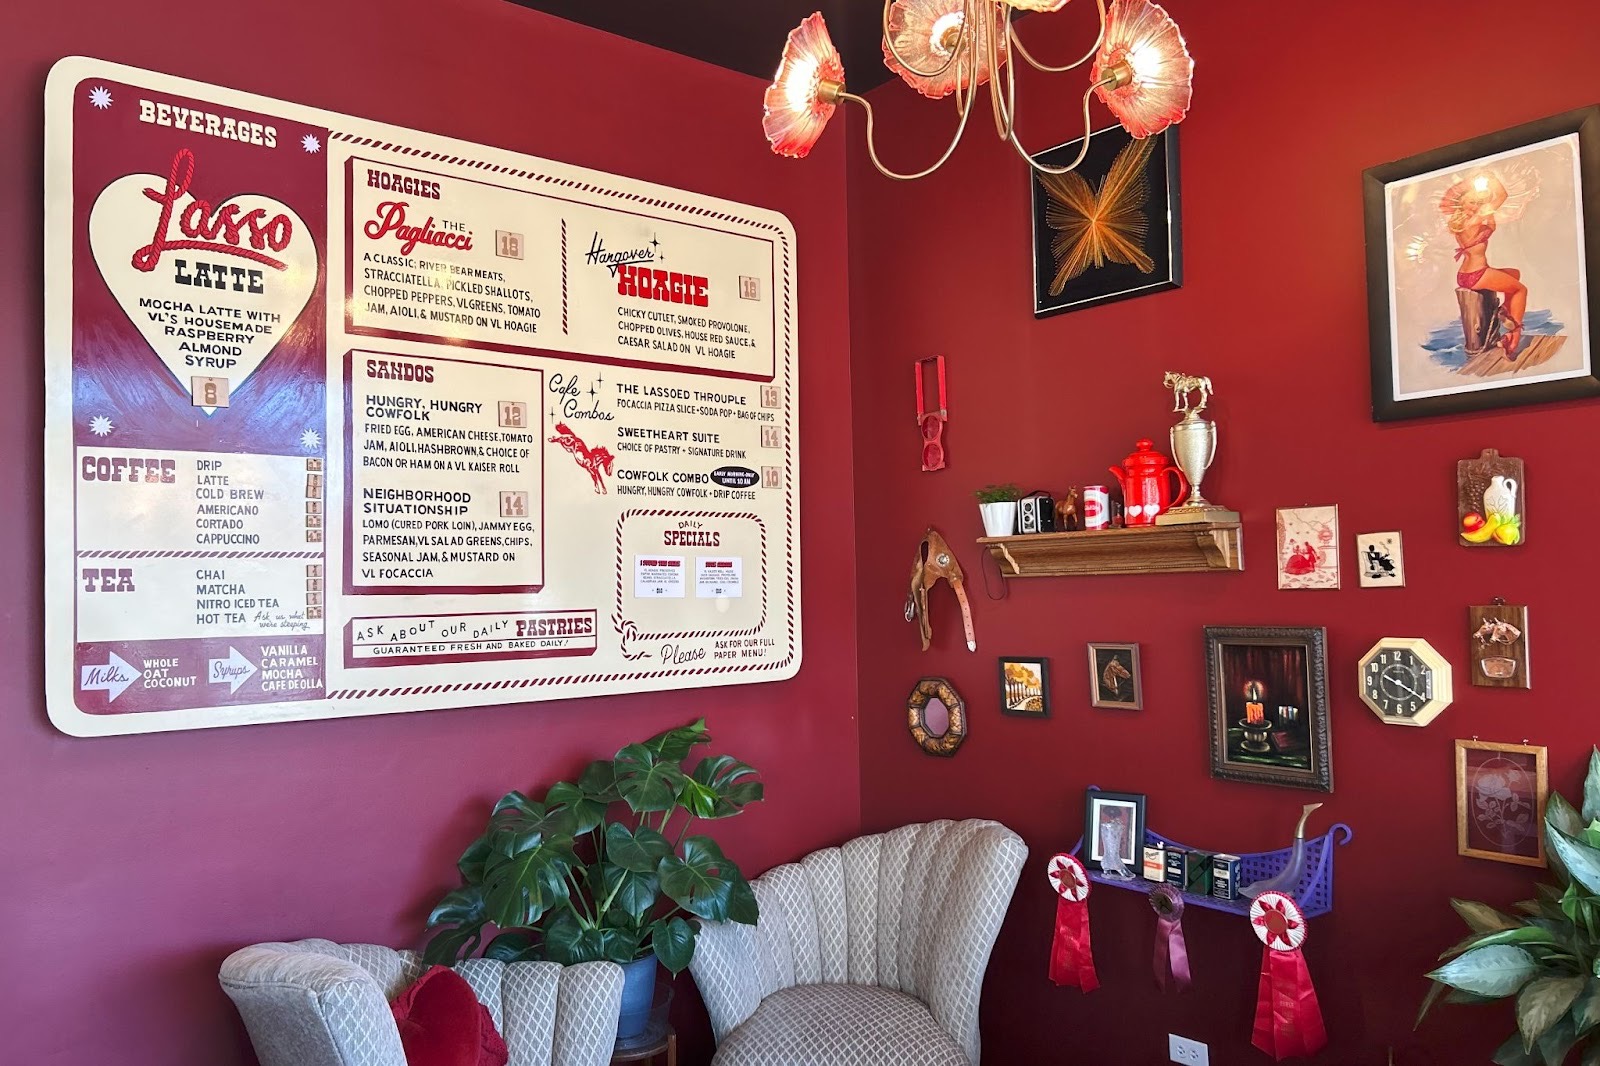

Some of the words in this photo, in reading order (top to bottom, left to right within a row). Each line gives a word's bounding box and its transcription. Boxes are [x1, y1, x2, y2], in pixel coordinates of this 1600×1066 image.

[139, 99, 277, 148] BEVERAGES
[368, 169, 440, 200] HOAGIES
[131, 148, 293, 272] Lasso
[364, 201, 473, 256] Pagliacci
[442, 220, 465, 232] THE
[502, 236, 518, 256] 18
[585, 231, 654, 278] Hangover
[420, 261, 446, 272] RIVER
[175, 259, 263, 294] LATTE
[447, 279, 483, 294] PICKLED
[485, 284, 533, 303] SHALLOTS,
[617, 264, 708, 307] HOAGIE
[364, 285, 408, 301] CHOPPED
[508, 304, 540, 318] TOMATO
[140, 298, 193, 312] MOCHA
[200, 305, 241, 318] LATTE
[247, 310, 281, 323] WITH
[618, 306, 646, 319] CHICKY
[678, 315, 706, 329] SMOKED
[185, 317, 272, 334] HOUSEMADE
[430, 311, 474, 326] MUSTARD
[476, 316, 488, 328] ON
[491, 318, 501, 329] VL
[504, 321, 537, 333] HOAGIE
[165, 326, 254, 343] RASPBERRY
[618, 321, 654, 334] CHOPPED
[685, 330, 708, 342] HOUSE
[709, 334, 723, 344] RED
[179, 342, 242, 356] ALMOND
[618, 335, 649, 349] CAESAR
[653, 340, 678, 352] SALAD
[680, 344, 690, 354] ON
[695, 346, 705, 356] VL
[708, 347, 736, 359] HOAGIE
[185, 355, 236, 368] SYRUP
[367, 360, 434, 383] SANDOS
[549, 373, 580, 404] Cafe
[617, 384, 639, 395] THE
[643, 386, 690, 400] LASSOED
[693, 392, 746, 405] THROUPLE
[366, 395, 425, 409] HUNGRY,
[430, 400, 482, 414] HUNGRY
[563, 398, 614, 422] Combos
[617, 399, 652, 411] FOCACCIA
[654, 402, 675, 412] PIZZA
[700, 406, 719, 417] SODA
[719, 409, 732, 418] POP
[737, 411, 749, 420] BAG
[757, 413, 774, 422] CHIPS
[366, 407, 430, 421] COWFOLK
[504, 407, 521, 425] 12
[365, 424, 391, 434] FRIED
[417, 427, 466, 440] AMERICAN
[502, 432, 532, 443] TOMATO
[617, 427, 689, 441] SWEETHEART
[692, 432, 720, 444] SUITE
[486, 447, 517, 458] CHOICE
[520, 449, 530, 458] OF
[617, 442, 642, 452] CHOICE
[644, 444, 653, 453] OF
[654, 445, 681, 454] PASTRY
[688, 446, 724, 457] SIGNATURE
[725, 449, 746, 459] DRINK
[82, 456, 176, 483] COFFEE
[196, 460, 222, 471] DRIP
[363, 456, 392, 467] BACON
[395, 458, 407, 468] OR
[410, 459, 431, 470] HAM
[434, 460, 445, 470] ON
[446, 461, 452, 470] A
[455, 461, 466, 471] VL
[469, 462, 496, 472] KAISER
[500, 464, 520, 473] ROLL
[197, 475, 229, 486] LATTE
[617, 470, 669, 482] COWFOLK
[672, 472, 709, 484] COMBO
[766, 471, 778, 486] 10
[196, 488, 224, 499] COLD
[230, 489, 264, 500] BREW
[363, 488, 471, 503] NEIGHBORHOOD
[648, 486, 674, 497] HUNGRY
[677, 488, 708, 498] COWFOLK
[713, 490, 730, 499] DRIP
[731, 491, 756, 500] COFFEE
[196, 504, 258, 516] AMERICANO
[363, 503, 468, 515] SITUATIONSHIP
[505, 496, 523, 516] 14
[196, 519, 243, 529] CORTADO
[363, 520, 389, 528] LOMO
[391, 519, 422, 530] (CURED
[426, 521, 449, 530] PORK
[479, 522, 511, 531] JAMMY
[513, 522, 535, 533] EGG,
[678, 521, 703, 529] DAILY
[196, 534, 260, 545] CAPPUCCINO
[431, 536, 463, 546] SALAD
[504, 537, 532, 547] CHIPS,
[664, 531, 720, 547] SPECIALS
[362, 552, 413, 562] SEASONAL
[450, 552, 499, 562] MUSTARD
[502, 553, 515, 561] ON
[196, 569, 225, 580] CHAI
[362, 569, 375, 578] VL
[380, 568, 433, 578] FOCACCIA
[82, 569, 135, 592] TEA
[196, 584, 245, 595] MATCHA
[196, 599, 231, 610] NITRO
[234, 599, 255, 608] ICED
[260, 599, 279, 608] TEA
[196, 614, 220, 624] HOT
[224, 613, 246, 623] TEA
[254, 611, 270, 622] Ask
[357, 624, 384, 641] ASK
[390, 620, 434, 642] ABOUT
[441, 622, 467, 638] OUR
[473, 620, 508, 639] DAILY
[516, 618, 592, 636] PASTRIES
[261, 645, 308, 656] VANILLA
[373, 644, 445, 655] GUARANTEED
[450, 643, 482, 652] FRESH
[486, 642, 503, 650] AND
[508, 640, 536, 649] BAKED
[660, 644, 706, 665] Please
[715, 640, 728, 648] ASK
[262, 656, 318, 667] CARAMEL
[1380, 654, 1386, 664] 11
[1410, 656, 1413, 665] 1
[1394, 651, 1401, 660] 12
[144, 658, 179, 668] WHOLE
[1371, 663, 1378, 672] 10
[1421, 665, 1426, 674] 2
[84, 666, 129, 685] Milks
[144, 669, 168, 679] OAT
[213, 661, 250, 681] Syrups
[262, 669, 303, 680] MOCHA
[144, 676, 197, 689] COCONUT
[262, 680, 287, 692] CAFE
[289, 680, 300, 690] DE
[300, 678, 323, 689] OLLA
[1367, 676, 1372, 686] 9
[1373, 690, 1378, 699] 8
[1383, 700, 1388, 709] 7
[1410, 702, 1416, 711] 5
[1397, 704, 1402, 714] 6
